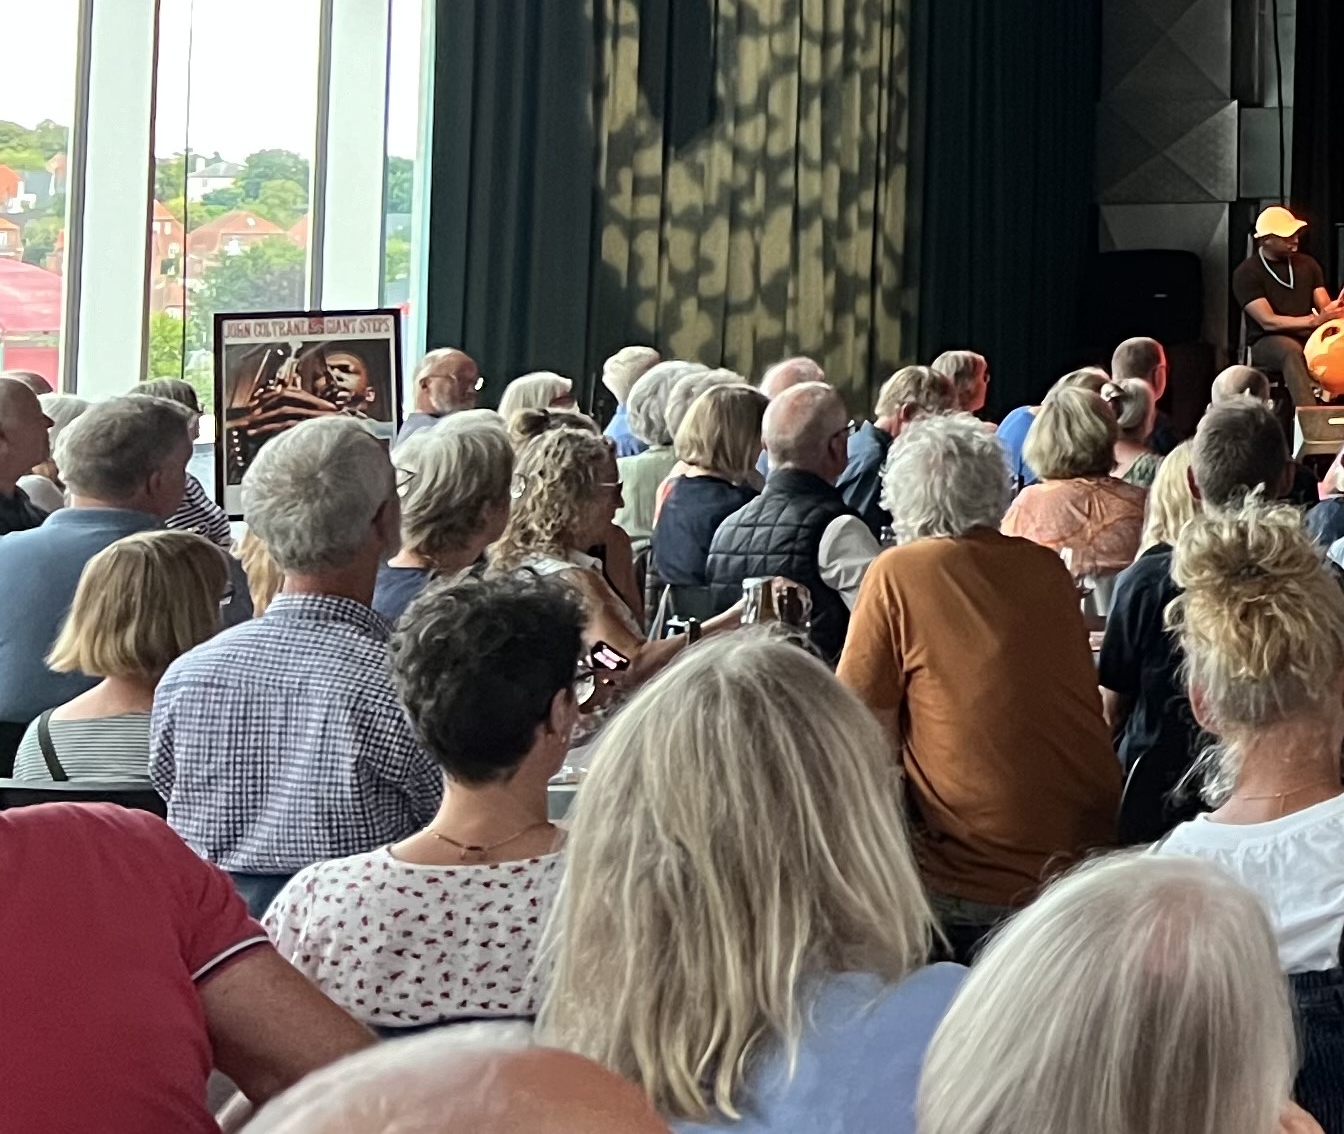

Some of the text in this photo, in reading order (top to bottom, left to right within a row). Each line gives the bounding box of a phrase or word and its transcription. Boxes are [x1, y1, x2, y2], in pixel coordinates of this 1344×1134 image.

[224, 317, 390, 338] JOHN COLTRANE GIANT STEPS
